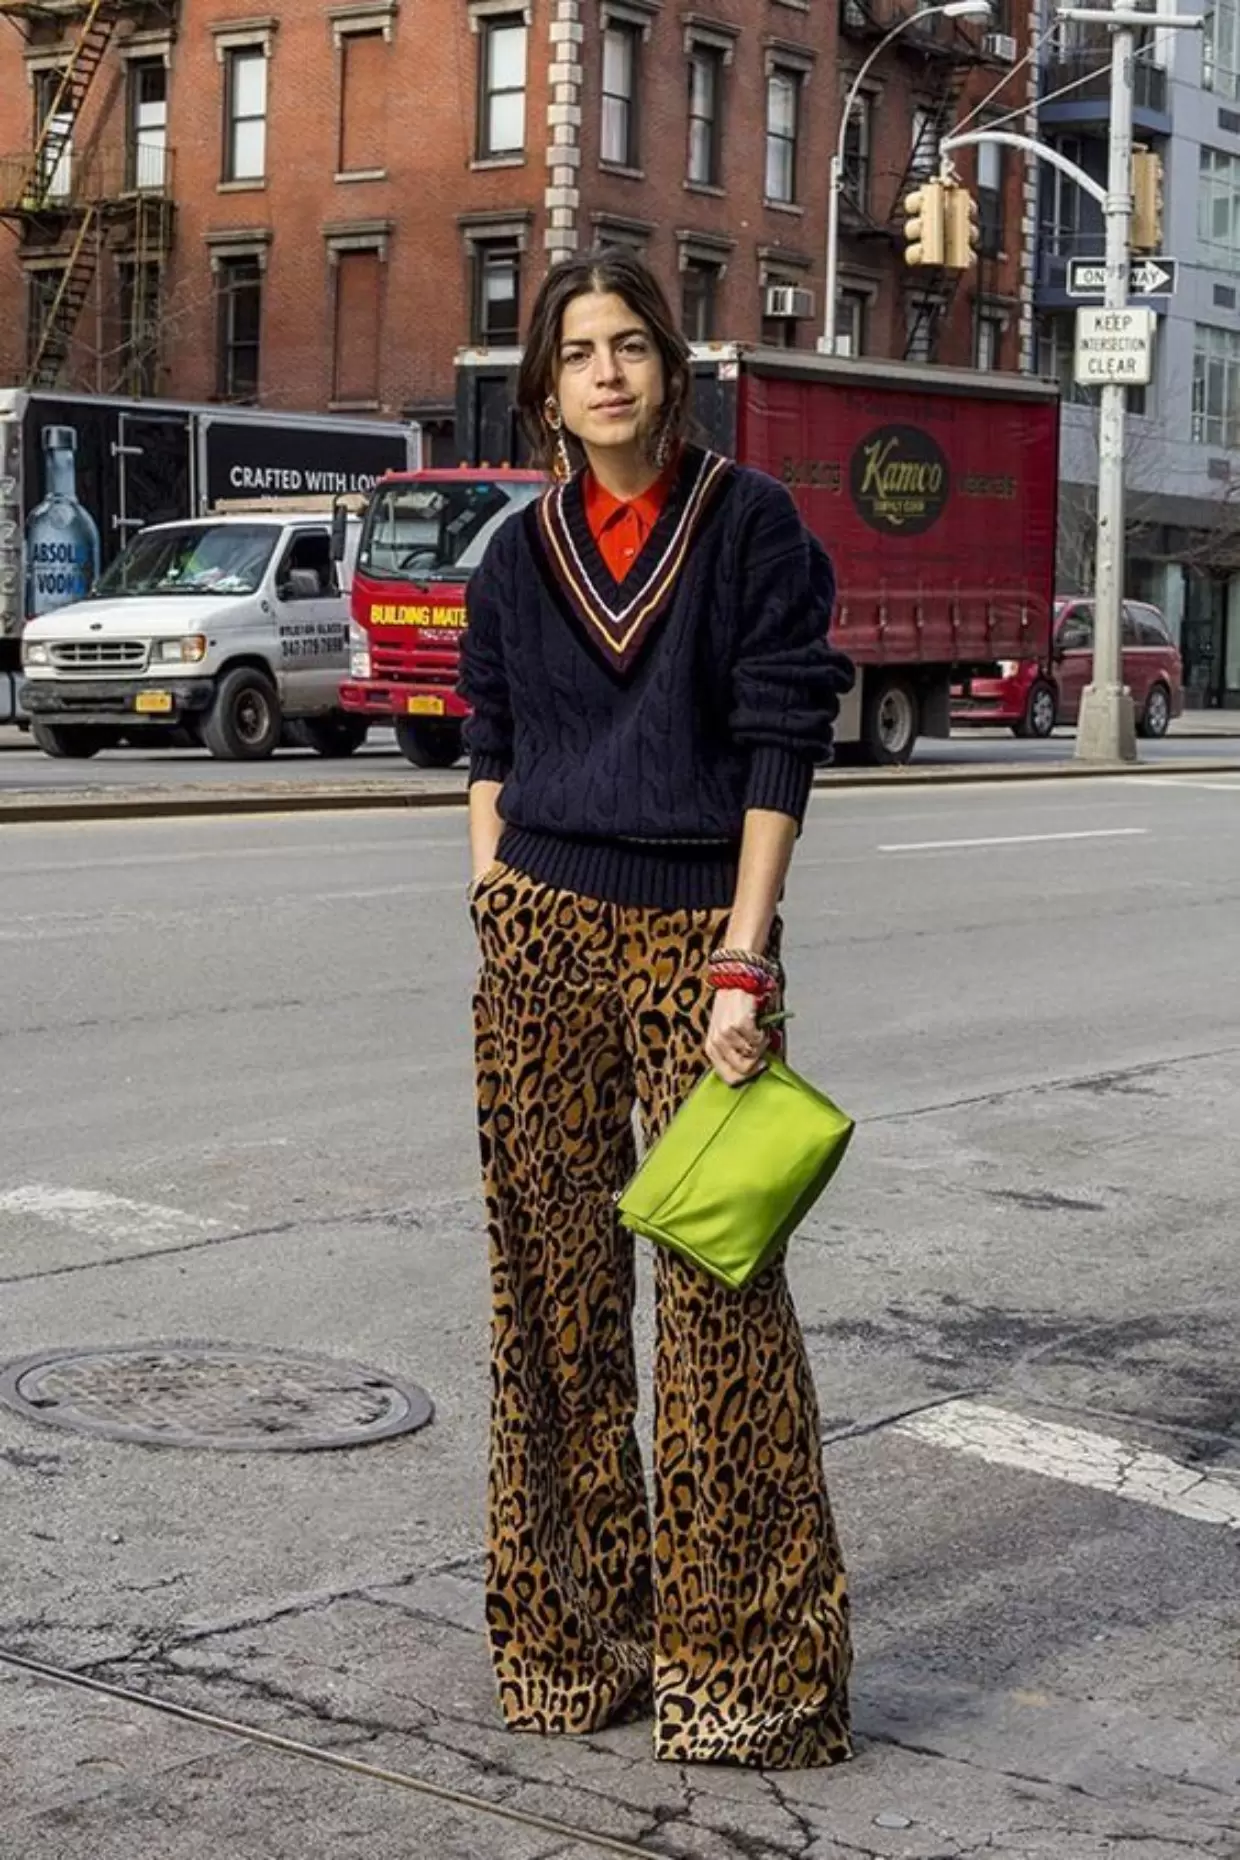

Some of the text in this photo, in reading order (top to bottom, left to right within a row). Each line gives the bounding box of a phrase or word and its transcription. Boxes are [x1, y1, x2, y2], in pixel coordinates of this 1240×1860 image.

[1083, 269, 1105, 284] ON
[1094, 315, 1133, 332] KEEP
[1080, 337, 1146, 351] INTERSECTION
[1088, 358, 1136, 374] CLEAR
[861, 436, 943, 498] Kamco
[230, 465, 378, 493] CRAFTED WITH LOV
[33, 543, 81, 563] ABSOL
[37, 573, 82, 594] VODK
[371, 604, 468, 627] BUILDING MATE
